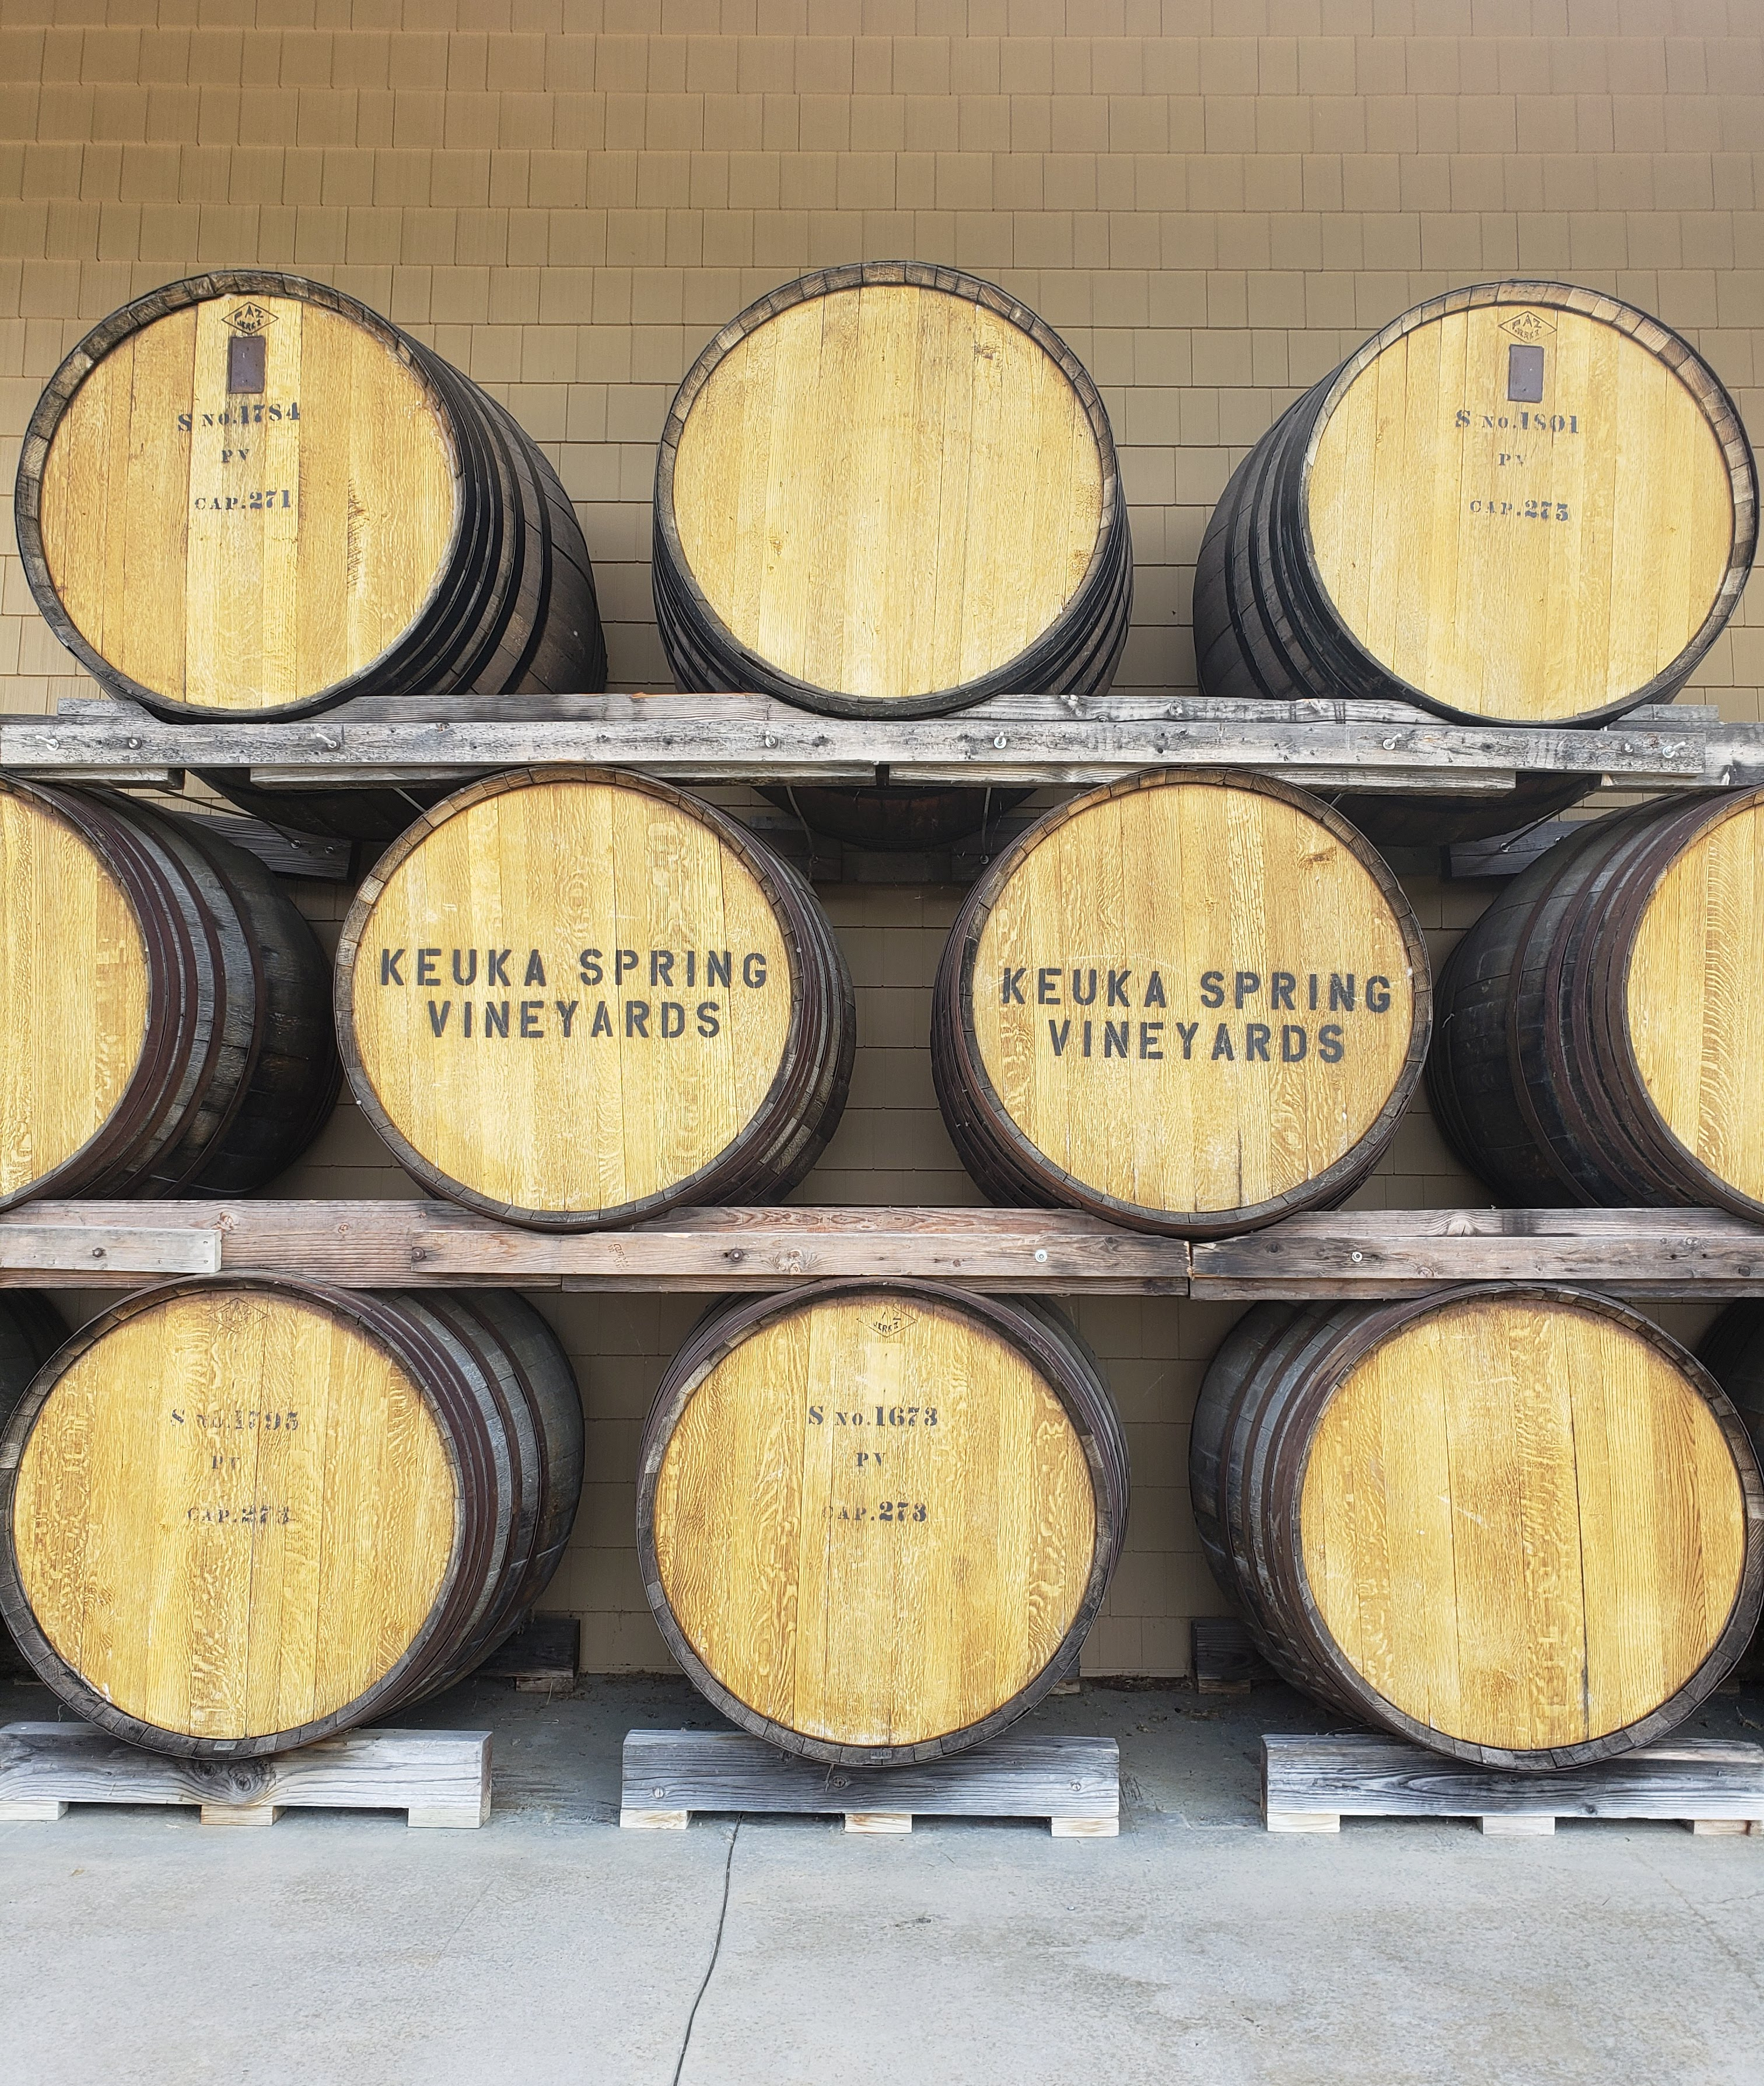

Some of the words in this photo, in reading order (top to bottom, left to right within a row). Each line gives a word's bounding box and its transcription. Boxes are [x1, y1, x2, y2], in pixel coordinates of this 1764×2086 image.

[380, 948, 547, 987] KEUKA
[579, 949, 767, 989] SPRING
[1002, 967, 1167, 1008] KEUKA
[1200, 971, 1391, 1014] SPRING
[428, 1000, 721, 1039] VINEYARDS
[1048, 1019, 1344, 1064] VINEYARDS
[808, 1406, 824, 1425] S
